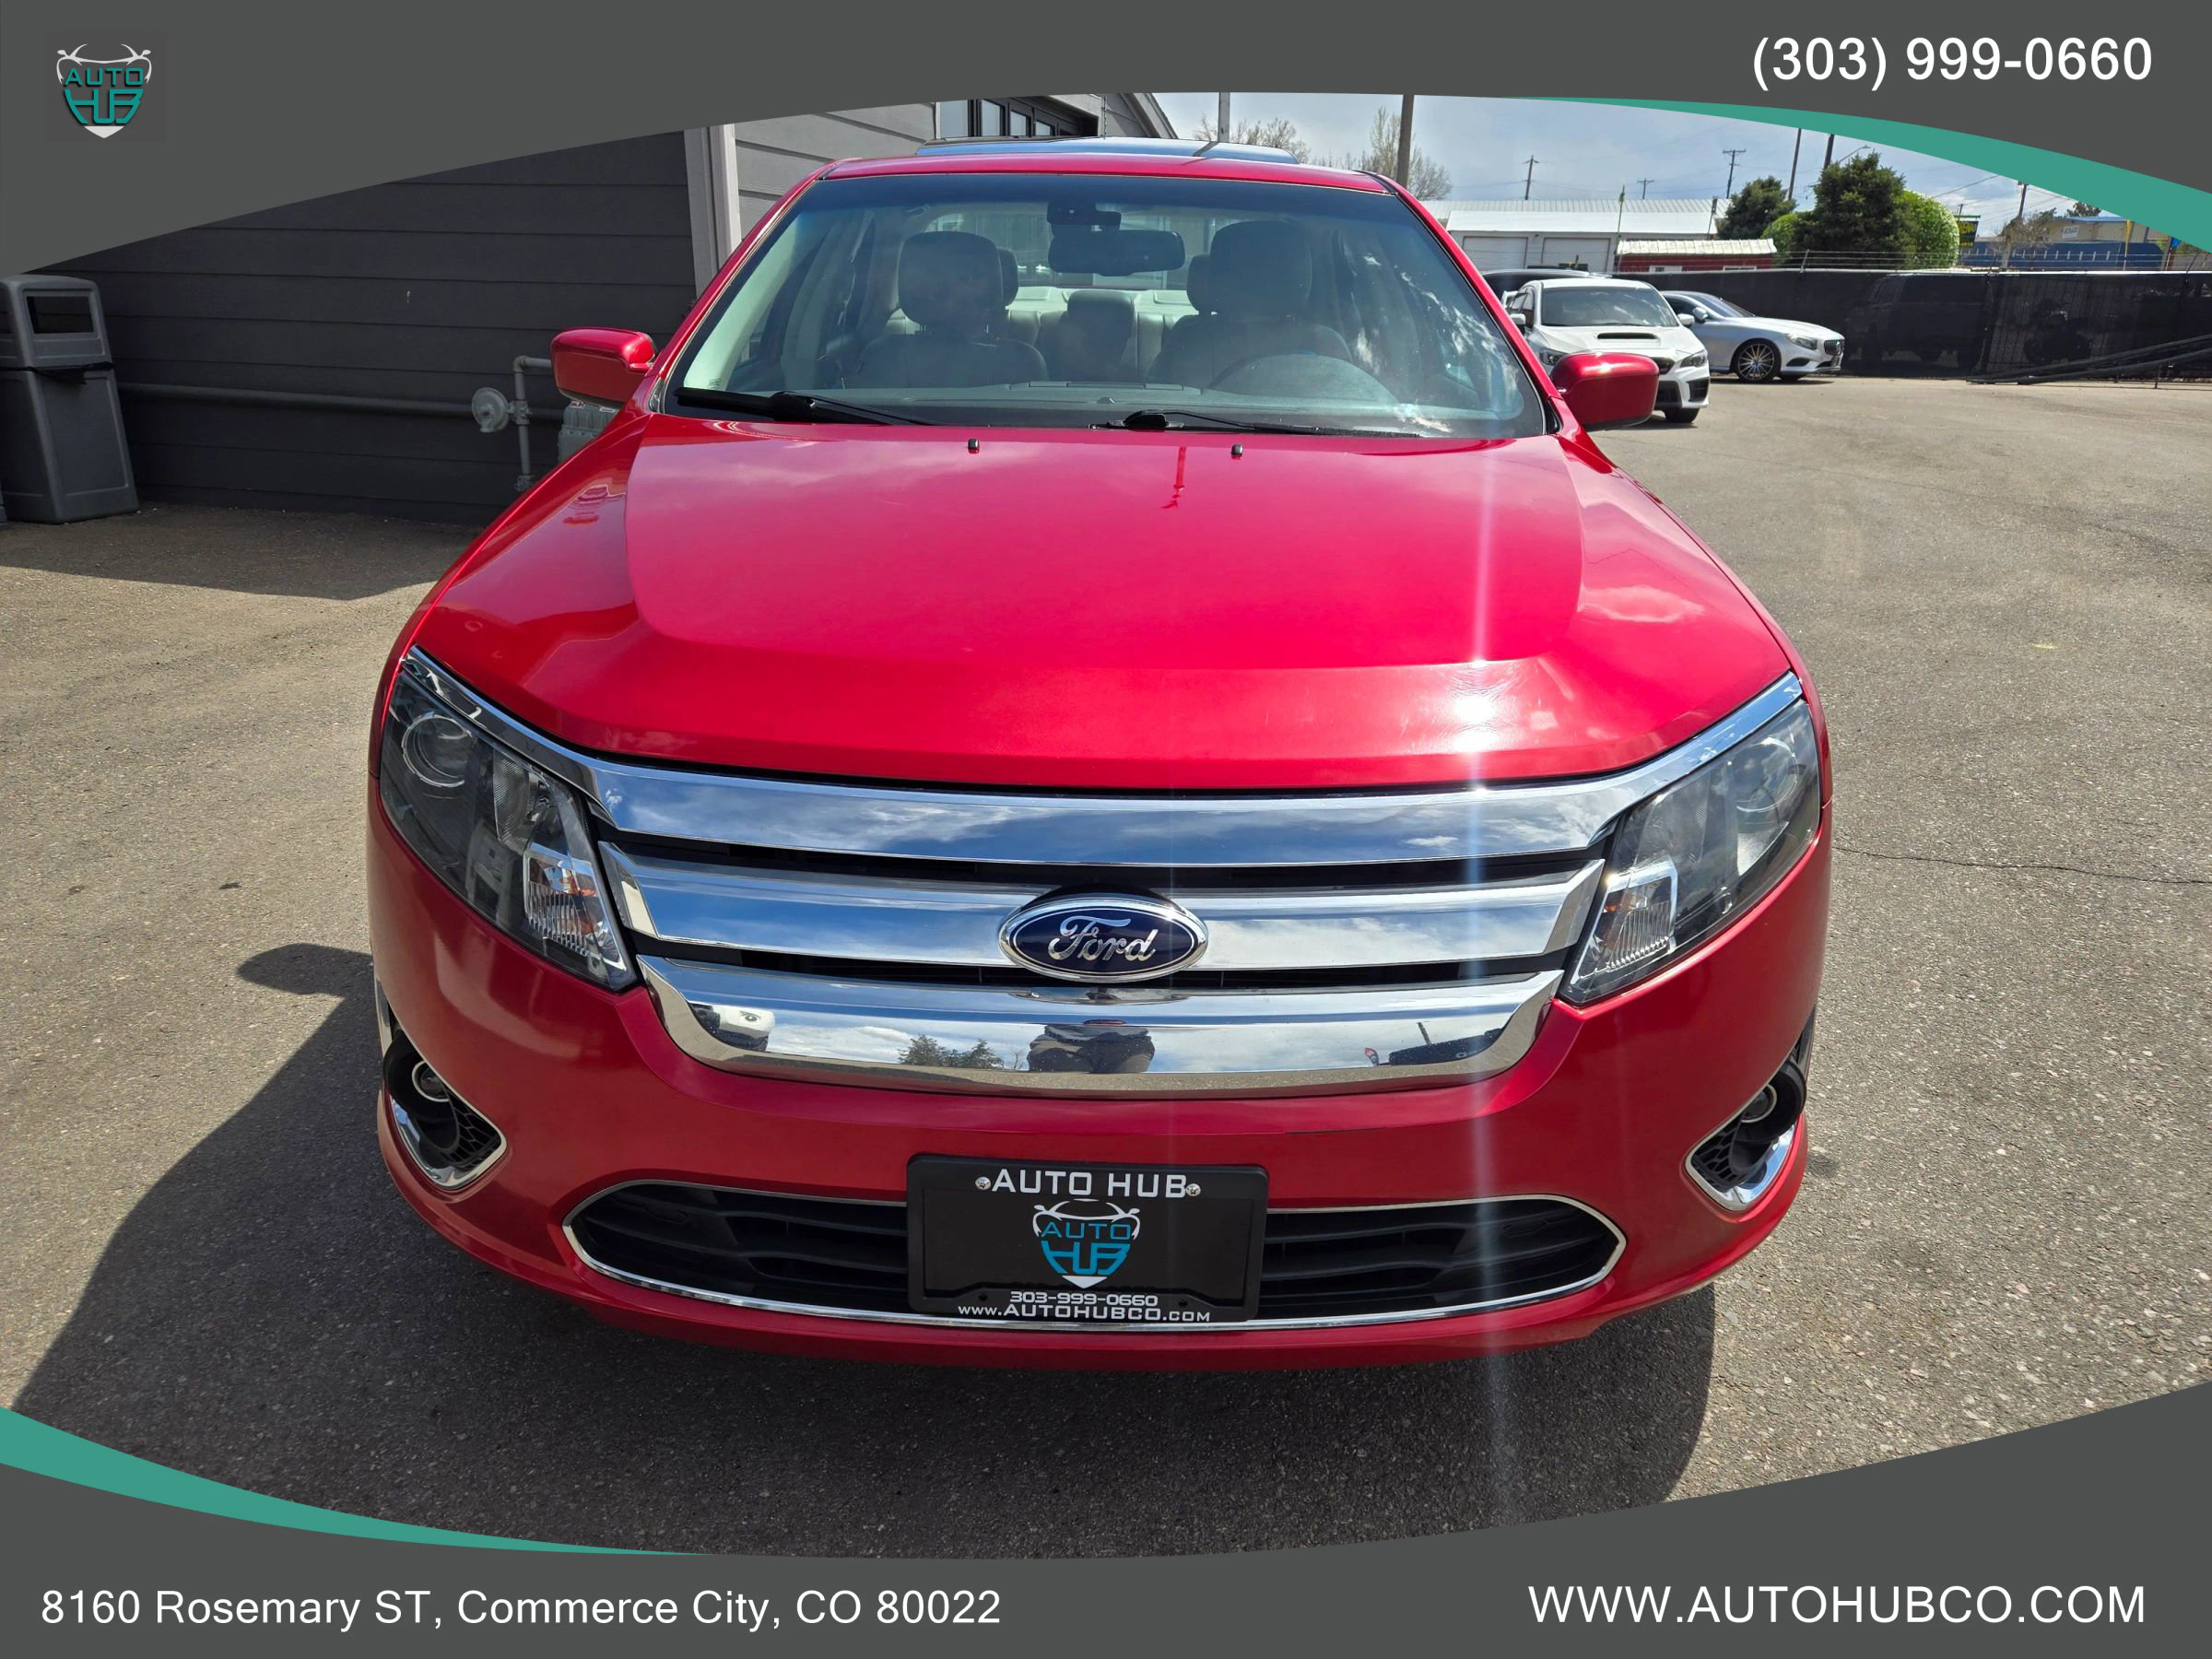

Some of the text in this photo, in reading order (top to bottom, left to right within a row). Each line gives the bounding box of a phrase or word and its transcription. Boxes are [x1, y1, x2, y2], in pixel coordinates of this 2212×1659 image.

[1048, 915, 1159, 961] Ford
[992, 1168, 1187, 1199] AUTO HUB
[1040, 1221, 1132, 1241] AUTO
[1009, 1290, 1159, 1307] 303-999-0660
